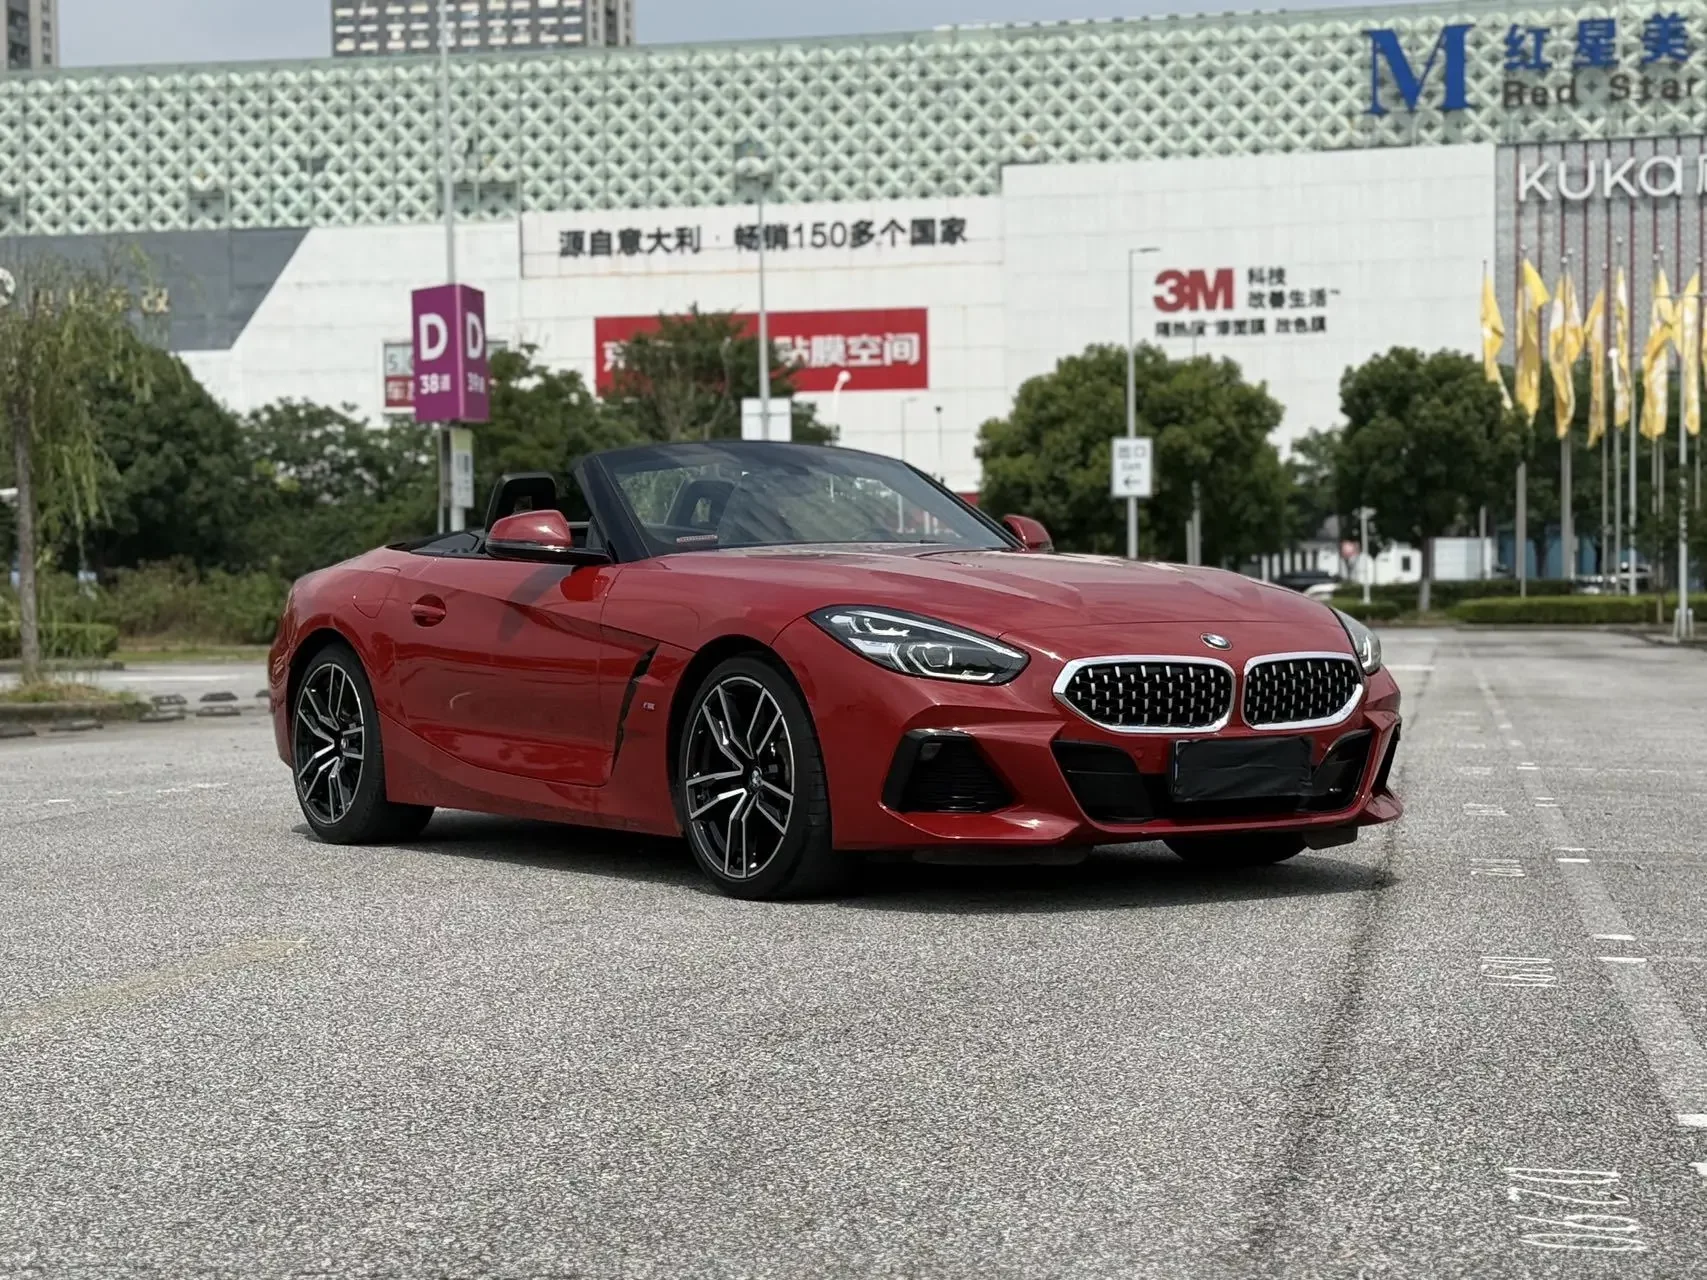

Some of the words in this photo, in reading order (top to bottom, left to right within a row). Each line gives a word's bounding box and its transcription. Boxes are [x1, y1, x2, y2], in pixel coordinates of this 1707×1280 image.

[1504, 13, 1690, 70] 红星美
[1362, 24, 1475, 114] M
[1503, 79, 1577, 109] Red
[1610, 72, 1700, 102] Star
[559, 226, 701, 257] 源自意大利
[734, 217, 968, 251] 畅销150多个国家
[1153, 268, 1235, 313] 3M
[419, 312, 448, 361] D
[466, 311, 484, 360] D
